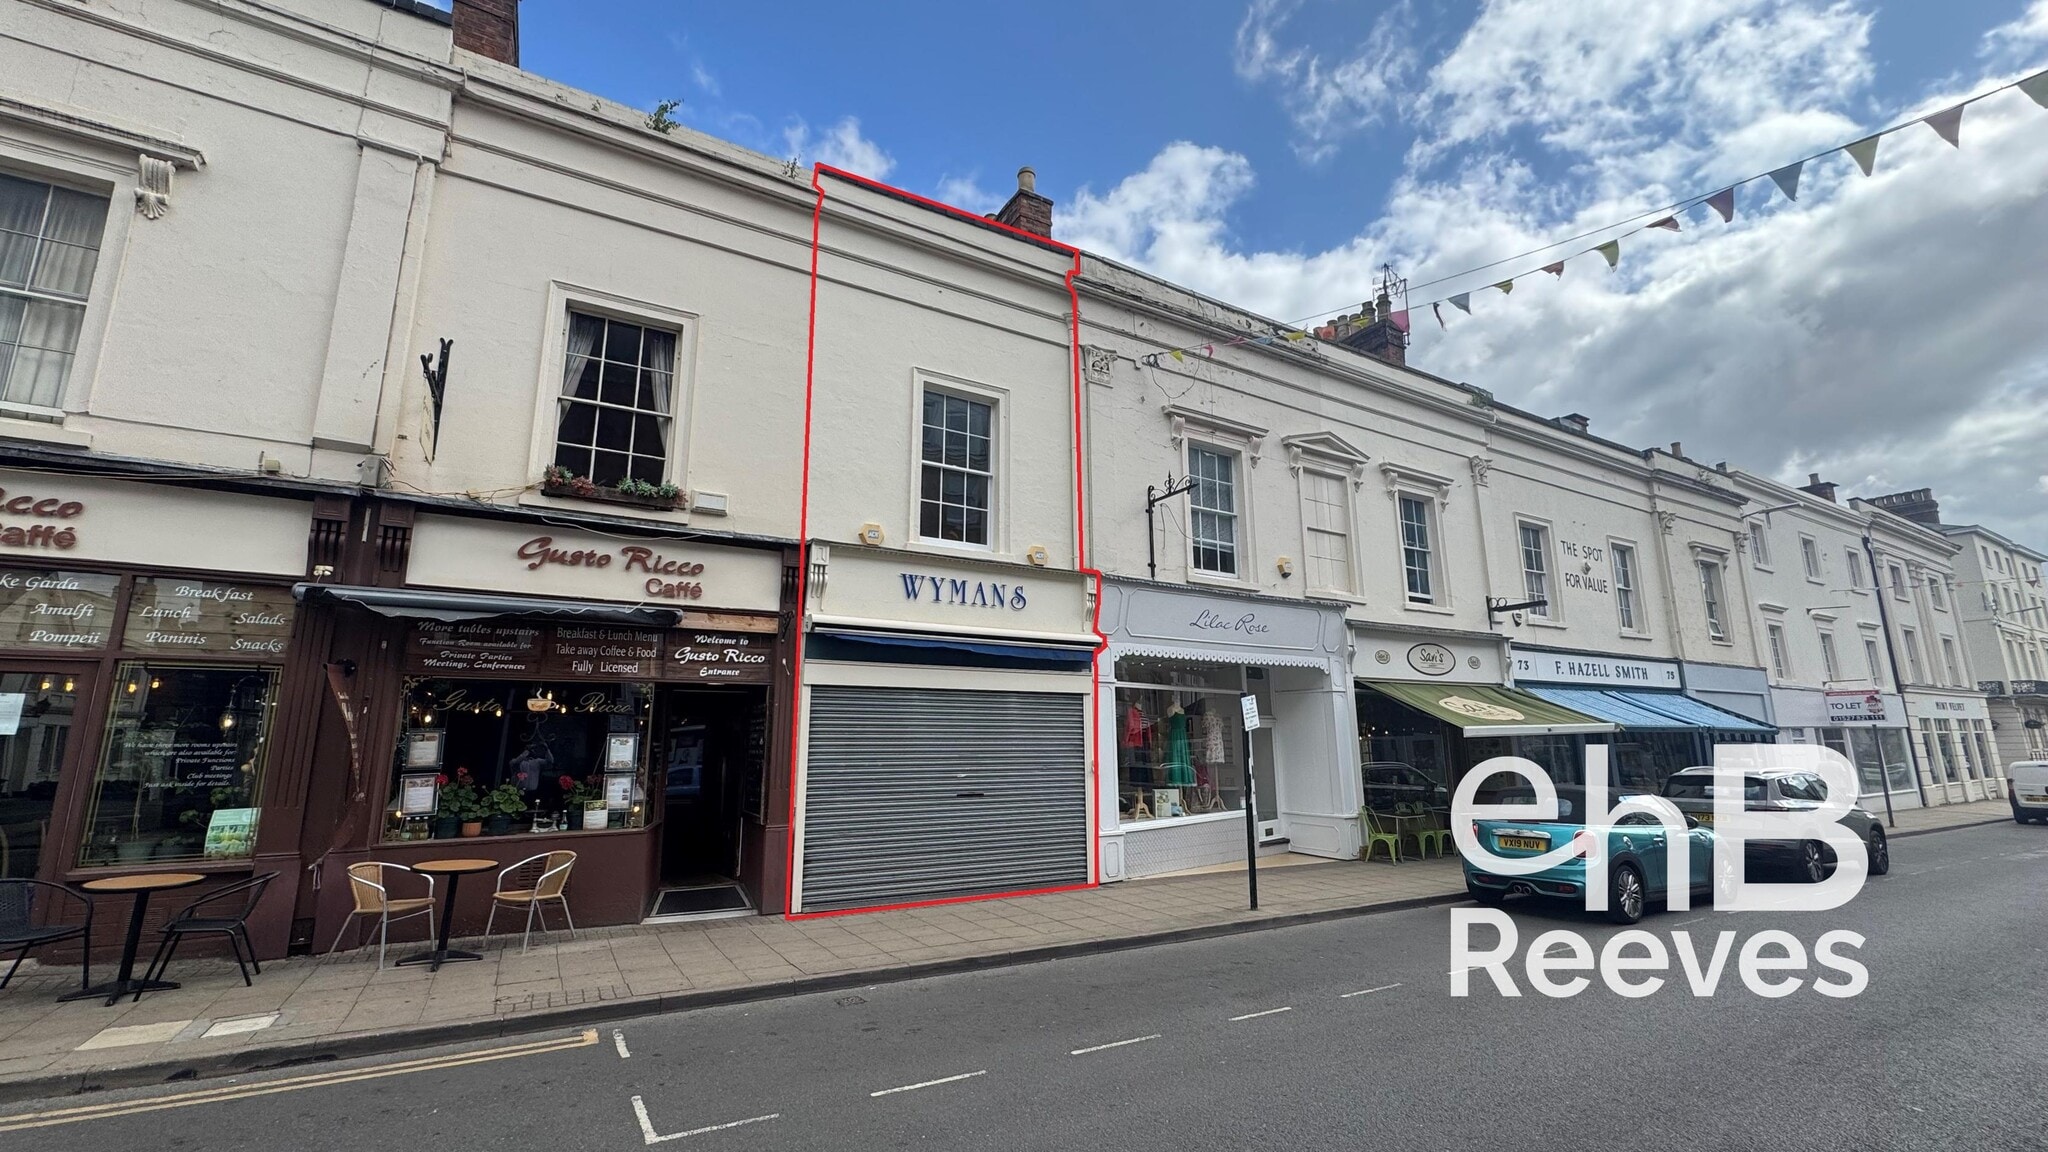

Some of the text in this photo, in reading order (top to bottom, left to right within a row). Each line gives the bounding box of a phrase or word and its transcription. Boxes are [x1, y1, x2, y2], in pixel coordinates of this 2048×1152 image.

[0, 523, 77, 549] affé
[518, 537, 705, 576] Gusto Ricco
[1561, 540, 1603, 562] THE SPOT
[25, 576, 81, 592] Garda
[645, 578, 703, 599] Caffé
[900, 573, 1027, 610] WYMANS
[1565, 572, 1608, 594] FOR VALUE
[175, 585, 255, 602] Breakfast
[30, 602, 95, 620] Amalfi
[138, 606, 286, 626] Lunch Salads
[418, 621, 540, 637] More tables upstairs
[1189, 609, 1270, 634] Lilac Rose
[29, 629, 102, 646] Pompeii
[144, 631, 284, 652] Paninis Snacks
[420, 637, 455, 646] Function
[483, 640, 518, 648] available
[557, 627, 658, 642] Breakfast & Lunch Menu
[694, 634, 750, 646] Welcome to
[440, 650, 513, 661] Private Parties
[556, 643, 657, 658] Take away Coffee & Food
[674, 646, 766, 664] Gusto Ricco
[423, 658, 526, 670] Meetings, Conferences
[572, 661, 639, 674] Fully Licensed
[699, 667, 740, 677] Entrance
[1517, 660, 1676, 680] 73 F. HAZELL SMITH 75
[433, 689, 633, 713] Gusto Ricco
[1830, 701, 1862, 710] TO LET
[1503, 838, 1540, 849] VX19 NUV
